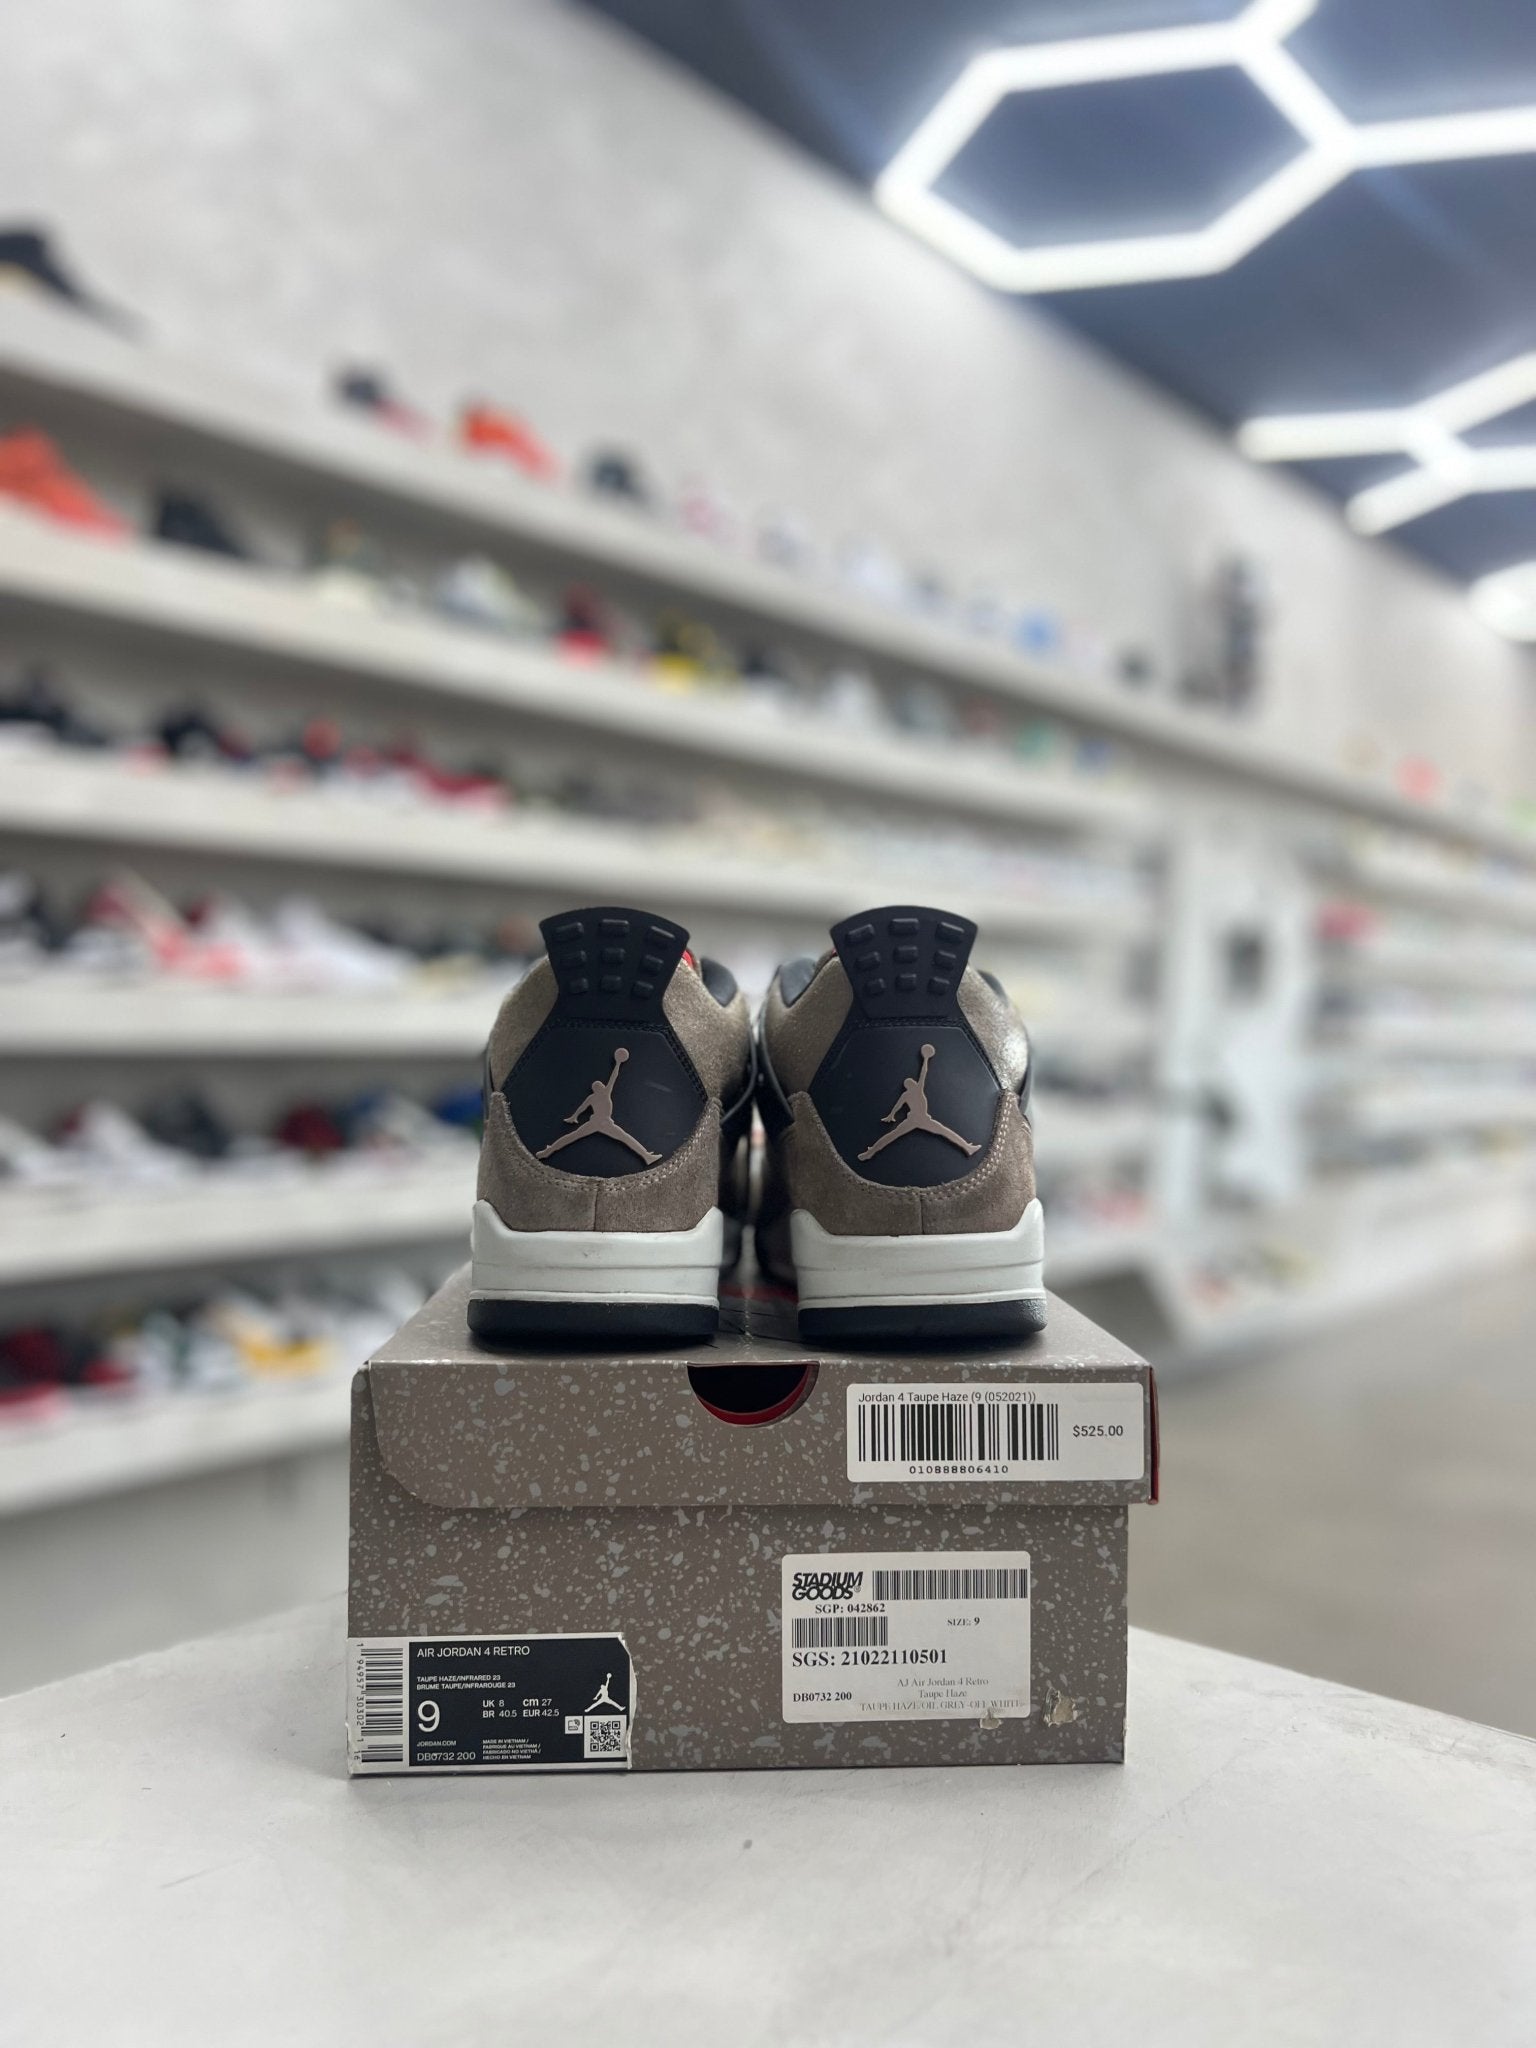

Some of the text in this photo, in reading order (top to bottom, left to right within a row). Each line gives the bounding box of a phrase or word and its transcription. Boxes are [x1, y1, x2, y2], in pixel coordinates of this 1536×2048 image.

[858, 1391, 1037, 1404] Jordan 4 Taupe Haze (9 (052021))
[1072, 1425, 1124, 1438] $525.00
[909, 1465, 1009, 1474] 010888806410
[792, 1571, 863, 1588] STADIUM
[792, 1586, 853, 1600] GOODS
[815, 1603, 886, 1614] SGP: 042862
[947, 1616, 981, 1626] SIZE: 9
[416, 1645, 531, 1658] AIR JORDAN 4 RETRO
[792, 1649, 947, 1667] SGS: 21022110501
[416, 1675, 438, 1683] TAUPE
[438, 1674, 491, 1682] HAZE/INFRARED
[897, 1676, 989, 1687] AJ Air Jordan 4 Retro
[441, 1682, 506, 1690] TAUPE/INFRAROUGE
[792, 1692, 852, 1703] DB0732 200
[918, 1689, 968, 1699] Taupe Haze
[482, 1698, 552, 1708] UK 8 cm 27
[417, 1700, 441, 1733] 9
[482, 1708, 560, 1719] BR 40.5 EUR 42.5
[416, 1751, 476, 1761] DB0732 200
